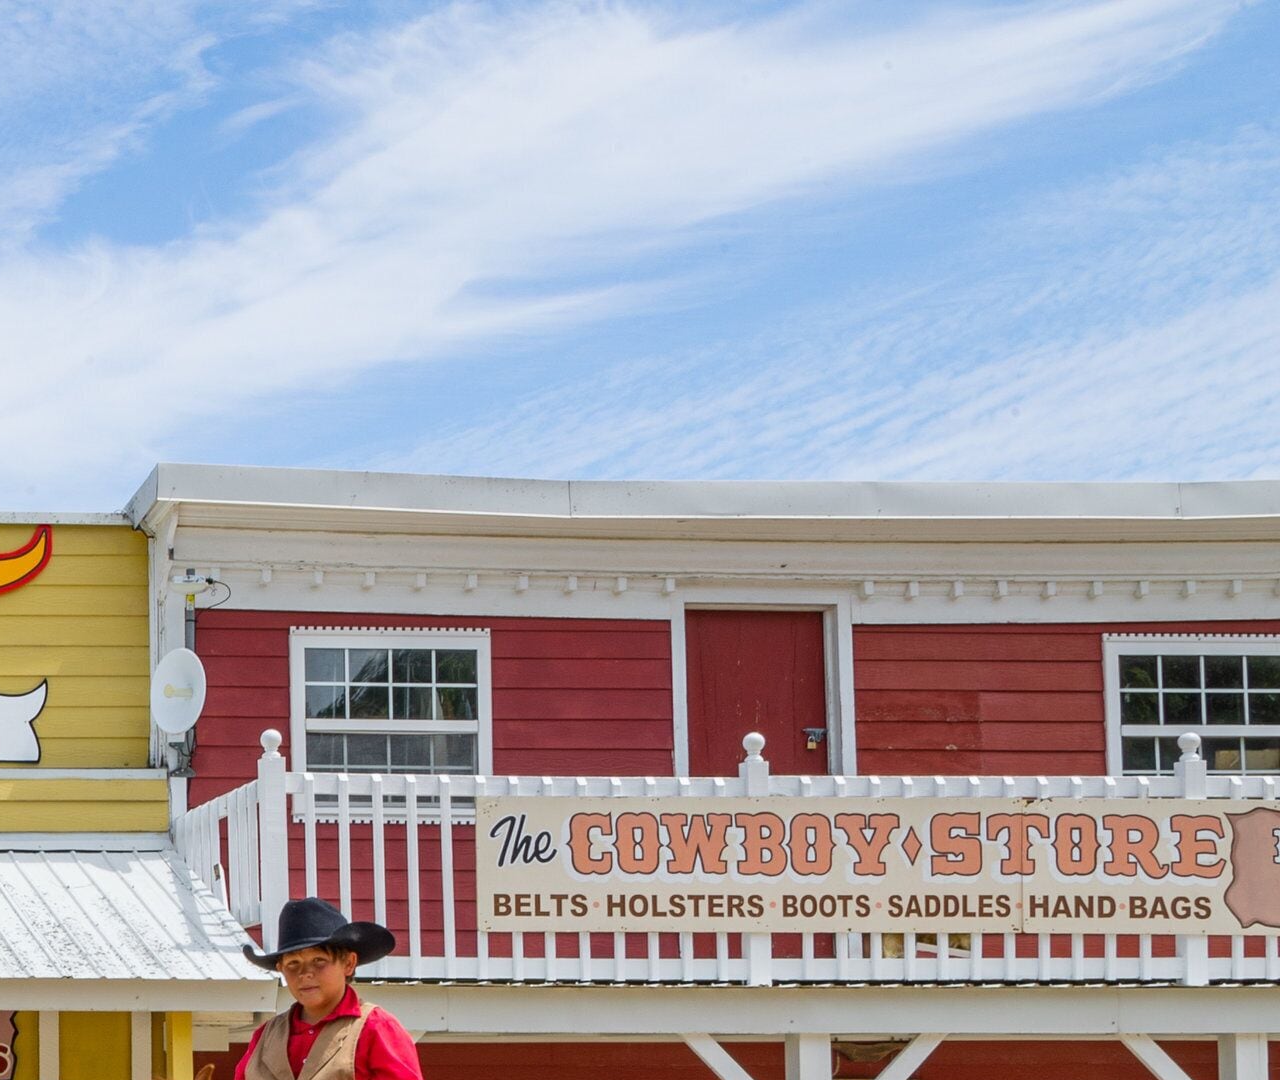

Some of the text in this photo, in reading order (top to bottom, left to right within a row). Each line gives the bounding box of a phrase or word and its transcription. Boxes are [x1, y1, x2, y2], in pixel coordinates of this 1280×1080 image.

[489, 813, 557, 868] The
[567, 811, 900, 877] COWBOY
[930, 812, 1227, 880] STORE
[493, 893, 1212, 920] BELTS HOLSTERS BOOTS SADDLES HAND BAGS
